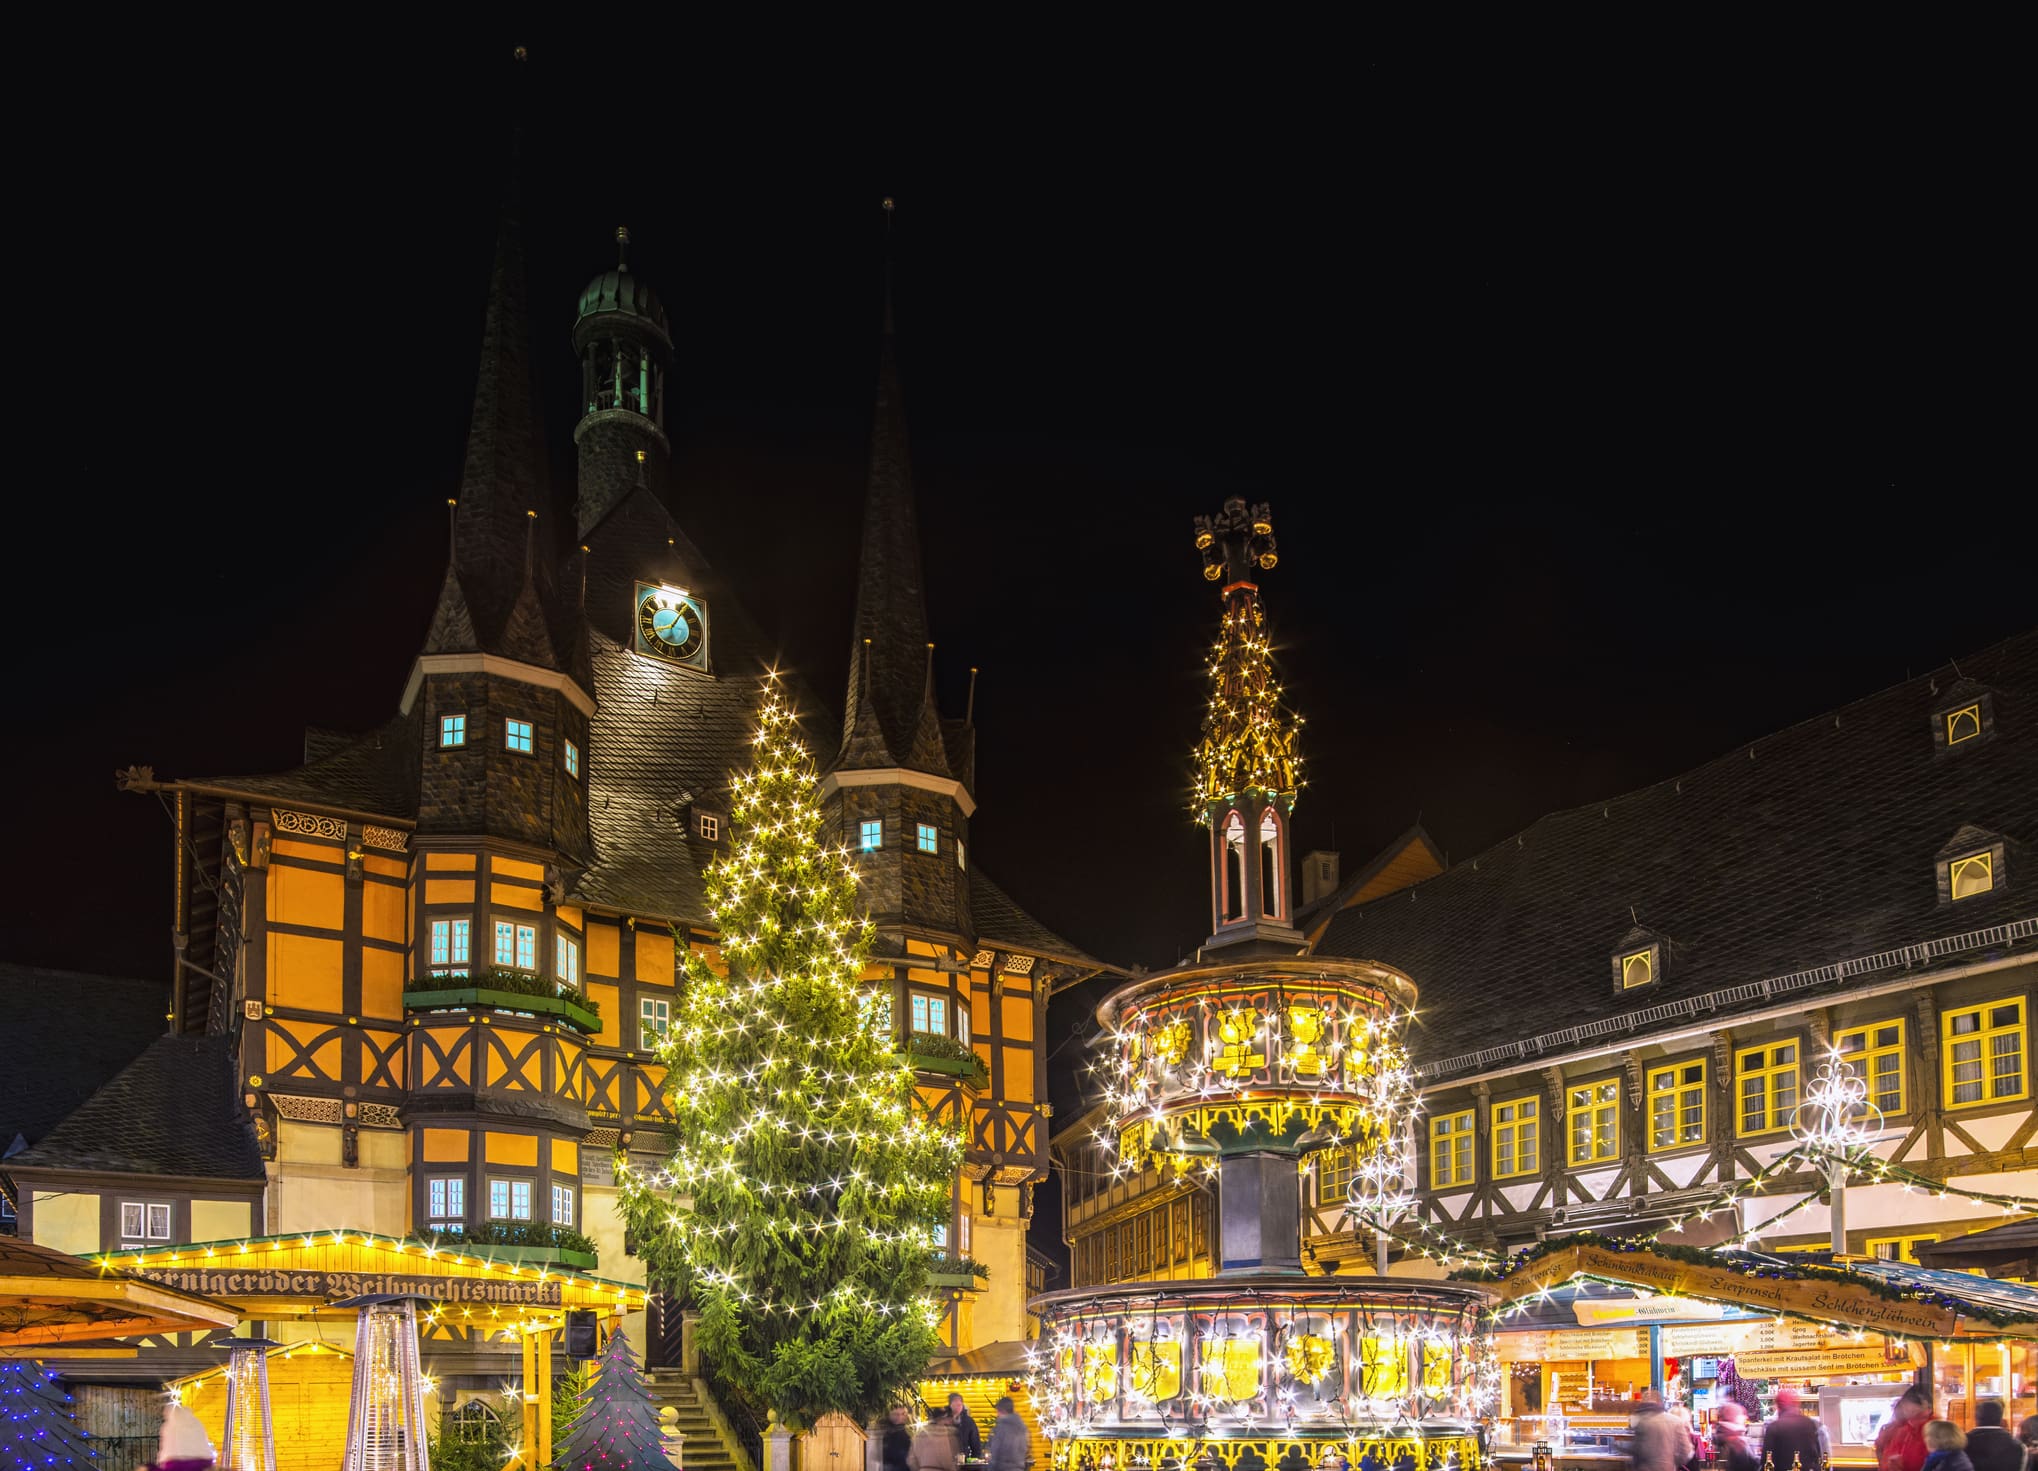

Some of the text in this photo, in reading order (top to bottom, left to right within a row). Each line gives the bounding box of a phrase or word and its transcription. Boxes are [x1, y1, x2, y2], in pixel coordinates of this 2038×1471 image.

[326, 1273, 561, 1305] Weihnachtsmarkt
[1709, 1277, 1783, 1301] Eierpunsch
[1811, 1295, 1939, 1332] Schlehenglühwein
[1786, 1354, 1821, 1362] Krautsalat
[1832, 1352, 1865, 1360] Brötchen
[1818, 1363, 1834, 1371] Senf
[1847, 1361, 1880, 1370] Brötchen
